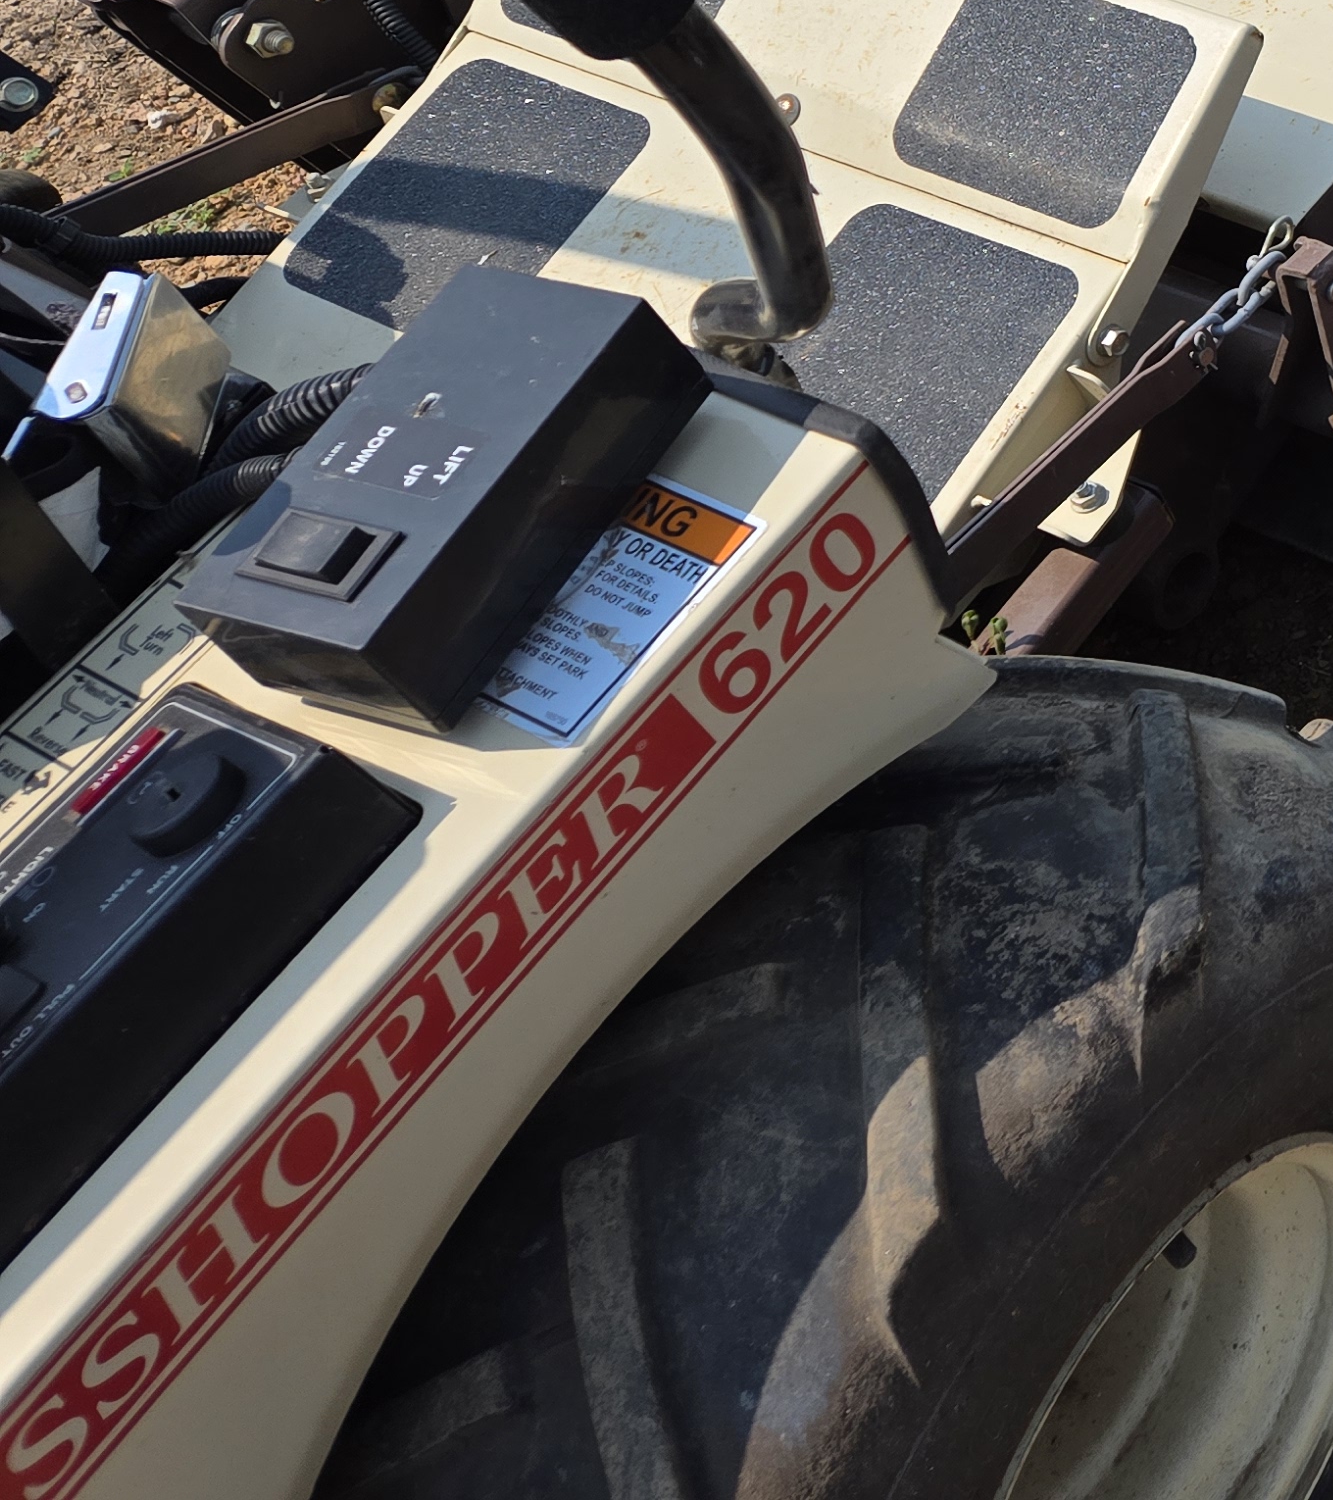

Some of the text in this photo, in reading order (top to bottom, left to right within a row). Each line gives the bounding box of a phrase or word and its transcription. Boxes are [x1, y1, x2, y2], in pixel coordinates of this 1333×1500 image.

[345, 426, 396, 474] DOWN
[433, 445, 474, 485] LIFT
[404, 464, 428, 487] UP
[622, 536, 656, 560] OR
[647, 548, 710, 584] DEATH
[583, 584, 652, 619] DO NOT JUMP
[594, 570, 662, 604] FOR DETAILS.
[148, 621, 175, 645] Left
[544, 604, 589, 628] OOTHLY
[138, 634, 168, 658] Turn
[512, 641, 589, 680] AYS SET PARK
[523, 630, 593, 665] LOPES WHEN
[493, 667, 560, 701] TTACHMENT
[90, 745, 140, 791] BRAKE
[217, 814, 242, 839] OFF
[100, 868, 143, 912] START
[146, 865, 179, 894] RUN
[23, 903, 45, 922] ON
[4, 511, 877, 1500] SSHOPPER 620
[34, 984, 75, 1021] PULL
